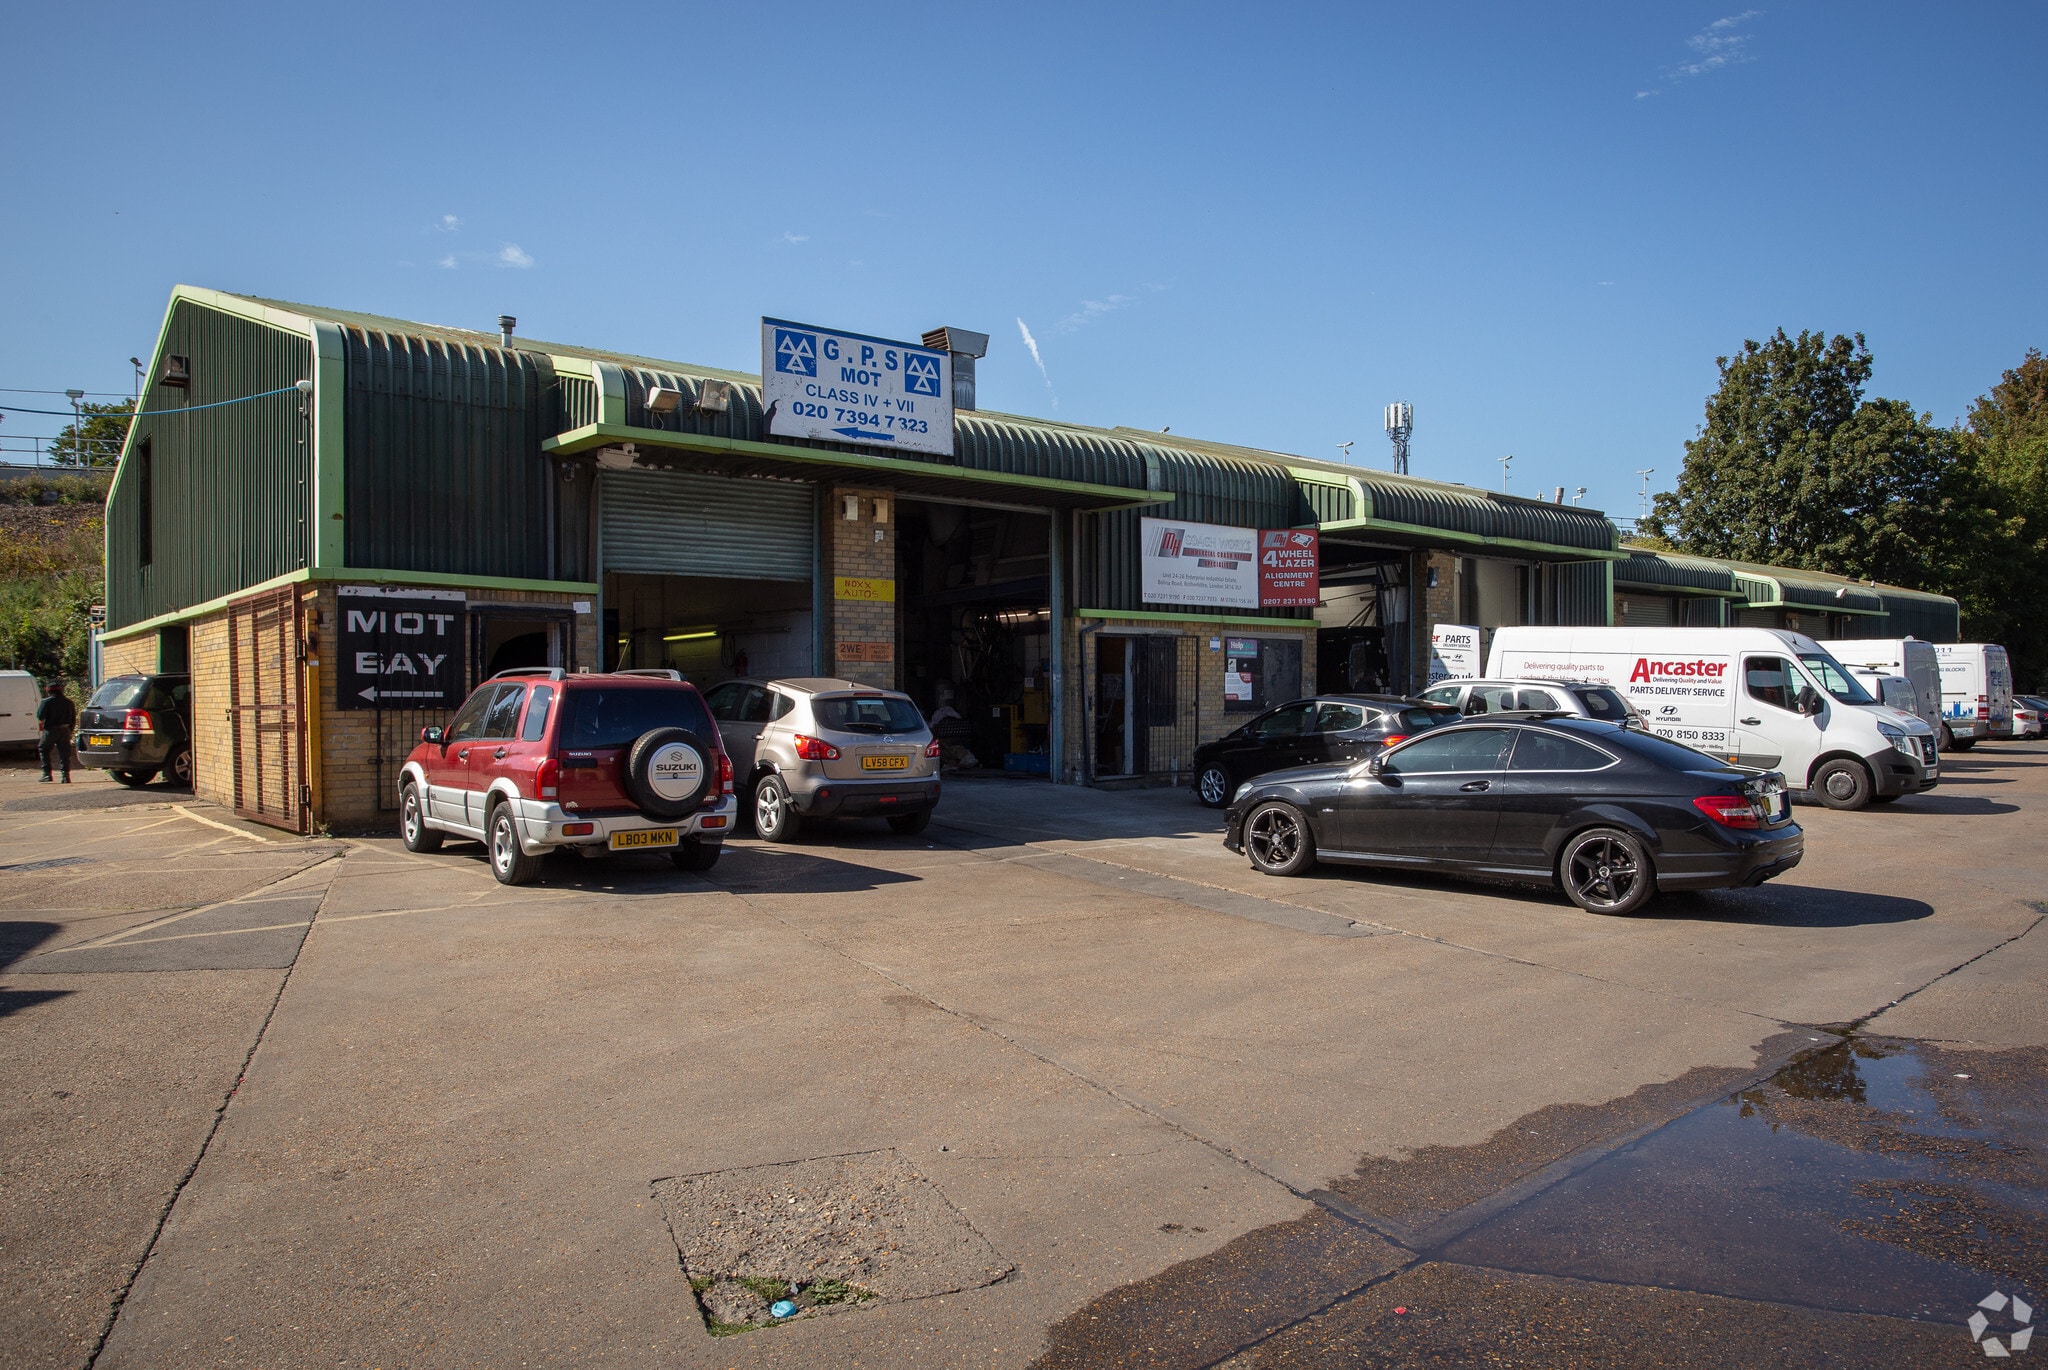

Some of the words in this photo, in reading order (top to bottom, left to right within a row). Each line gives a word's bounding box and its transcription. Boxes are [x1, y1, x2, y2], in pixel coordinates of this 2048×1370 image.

[841, 367, 882, 388] MOT
[805, 383, 859, 404] CLASS
[864, 394, 879, 408] IV
[883, 399, 892, 407] +
[896, 398, 914, 413] VII
[792, 401, 828, 419] 020
[835, 407, 880, 428] 7394
[884, 415, 928, 434] 7323
[1184, 534, 1217, 548] COACH
[1263, 551, 1278, 568] 4
[1278, 549, 1315, 558] WHEEL
[1278, 559, 1315, 568] LAZER
[844, 579, 872, 589] NOXX
[843, 589, 880, 598] AUTOS
[347, 610, 455, 636] MOT
[1445, 635, 1471, 644] PARTS
[840, 643, 862, 654] 2WE
[355, 652, 448, 676] BAY
[1523, 661, 1556, 671] Delivering
[1557, 662, 1578, 672] quality
[1629, 658, 1728, 683] Ancaster
[1652, 677, 1678, 685] Delivering
[1630, 686, 1654, 694] PARTS
[1655, 686, 1693, 695] DELIVERY
[1693, 687, 1725, 697] SERVICE
[1656, 728, 1673, 738] 020
[1676, 730, 1699, 739] 8150
[1701, 731, 1725, 741] 8333
[656, 763, 697, 771] SUZUKI
[865, 758, 888, 767] LV58
[889, 757, 905, 767] CFX
[617, 833, 648, 846] LB03
[651, 832, 673, 843] MKN
